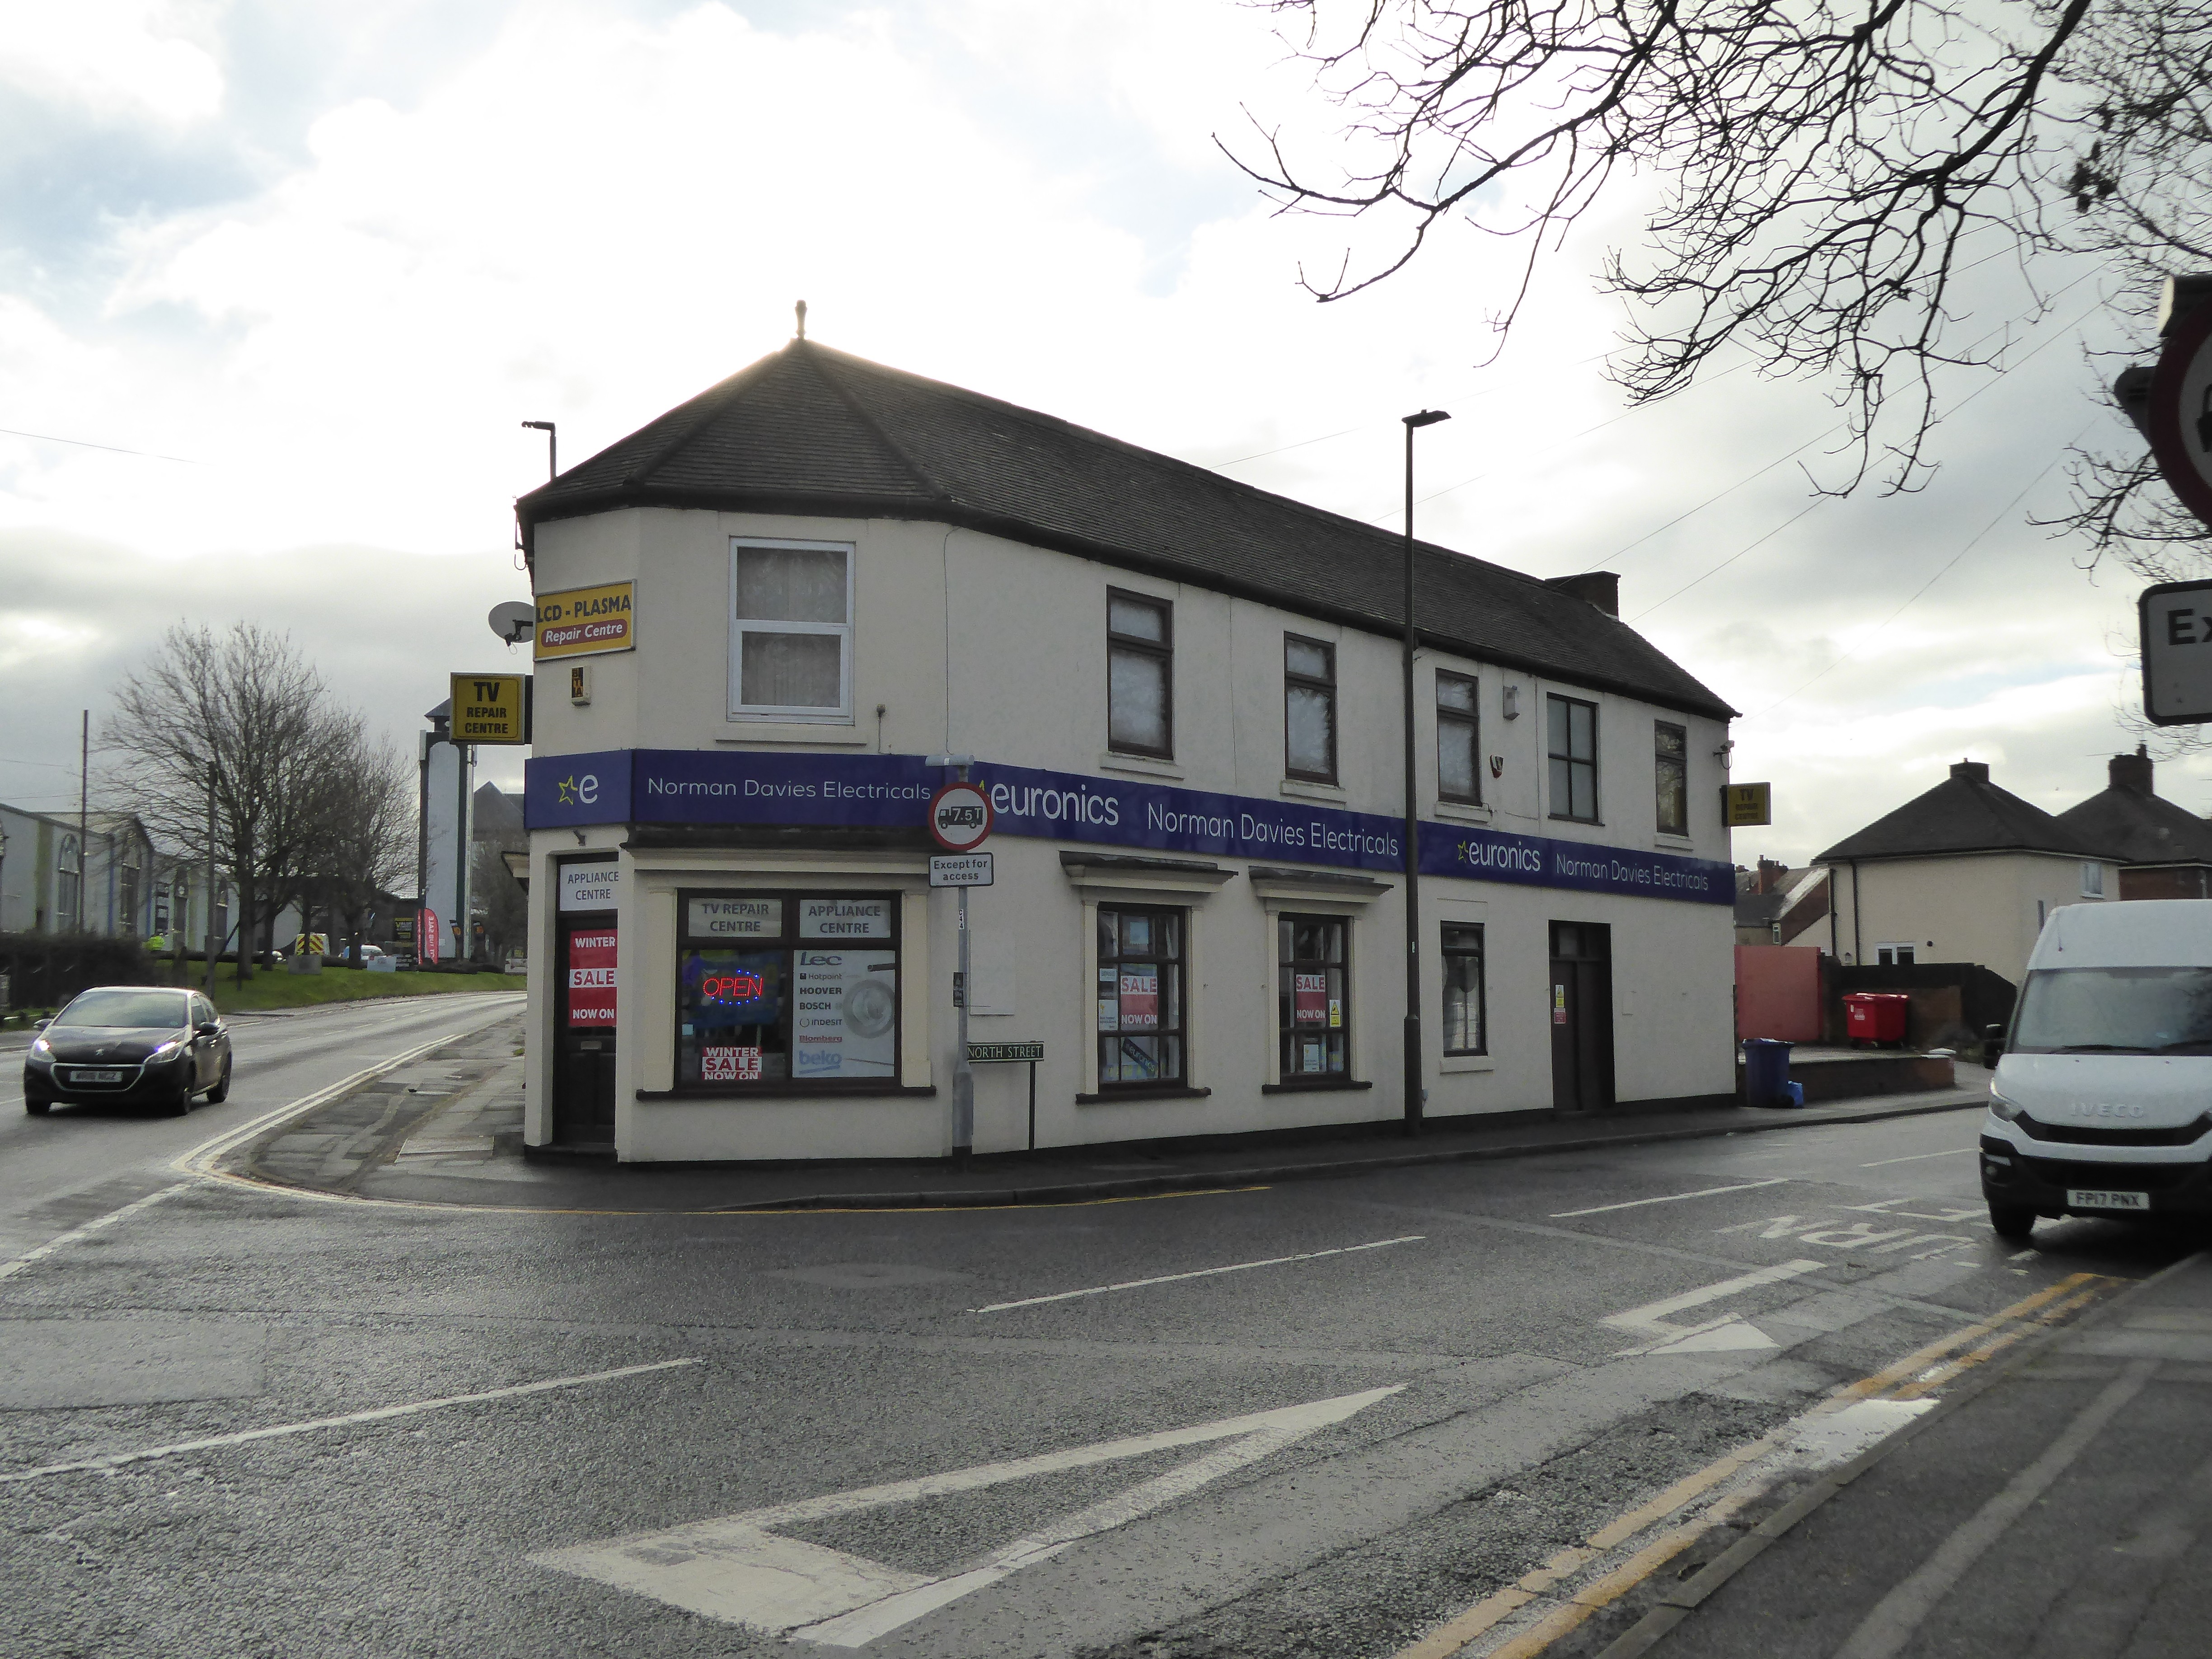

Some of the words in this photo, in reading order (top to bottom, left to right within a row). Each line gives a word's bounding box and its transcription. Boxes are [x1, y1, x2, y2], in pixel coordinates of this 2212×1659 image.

[536, 605, 562, 623] LCD
[574, 595, 631, 618] PLASMA
[545, 627, 580, 645] Repair
[585, 623, 623, 638] Centre
[473, 681, 500, 702] TV
[467, 707, 507, 718] REPAIR
[465, 723, 508, 734] CENTRE
[647, 778, 737, 797] Norman
[745, 779, 816, 798] Davies
[823, 781, 931, 800] Electricals
[991, 783, 1119, 826] euronics
[1148, 802, 1234, 839] Norman
[1241, 813, 1305, 846] Davies
[1311, 821, 1399, 857] Electricals
[1468, 840, 1541, 872] euronics
[933, 859, 970, 872] Except
[972, 859, 988, 868] for
[1556, 853, 1608, 880] Norman
[1612, 860, 1651, 885] Davies
[1654, 865, 1709, 891] Electricals
[567, 871, 619, 884] APPLIANCE
[943, 871, 979, 881] access
[575, 888, 611, 900] CENTRE
[702, 903, 720, 915] TV
[723, 904, 769, 915] REPAIR
[808, 905, 881, 917] APPLIANCE
[710, 921, 761, 932] CENTRE
[819, 922, 869, 934] CENTRE
[575, 937, 616, 948] WINTER
[800, 951, 843, 966] Lec
[574, 970, 615, 986] SALE
[809, 973, 842, 981] Hotpoint
[1297, 976, 1325, 990] SALE
[703, 976, 764, 997] OPEN
[799, 987, 842, 995] HOOVER
[1121, 977, 1157, 993] SALE
[799, 1002, 831, 1010] BOSCH
[572, 1009, 598, 1019] NOW
[599, 1008, 615, 1019] ON
[1121, 1014, 1143, 1025] NOW
[1144, 1014, 1157, 1025] ON
[1296, 1009, 1314, 1019] NOW
[1315, 1009, 1326, 1019] ON
[706, 1047, 759, 1057] WINTER
[799, 1050, 843, 1065] beko
[968, 1046, 1003, 1059] NORTH
[1008, 1045, 1041, 1058] STREET
[705, 1057, 758, 1071] SALE
[704, 1072, 737, 1080] NOW
[739, 1072, 758, 1080] ON
[2069, 1102, 2144, 1119] IVECO
